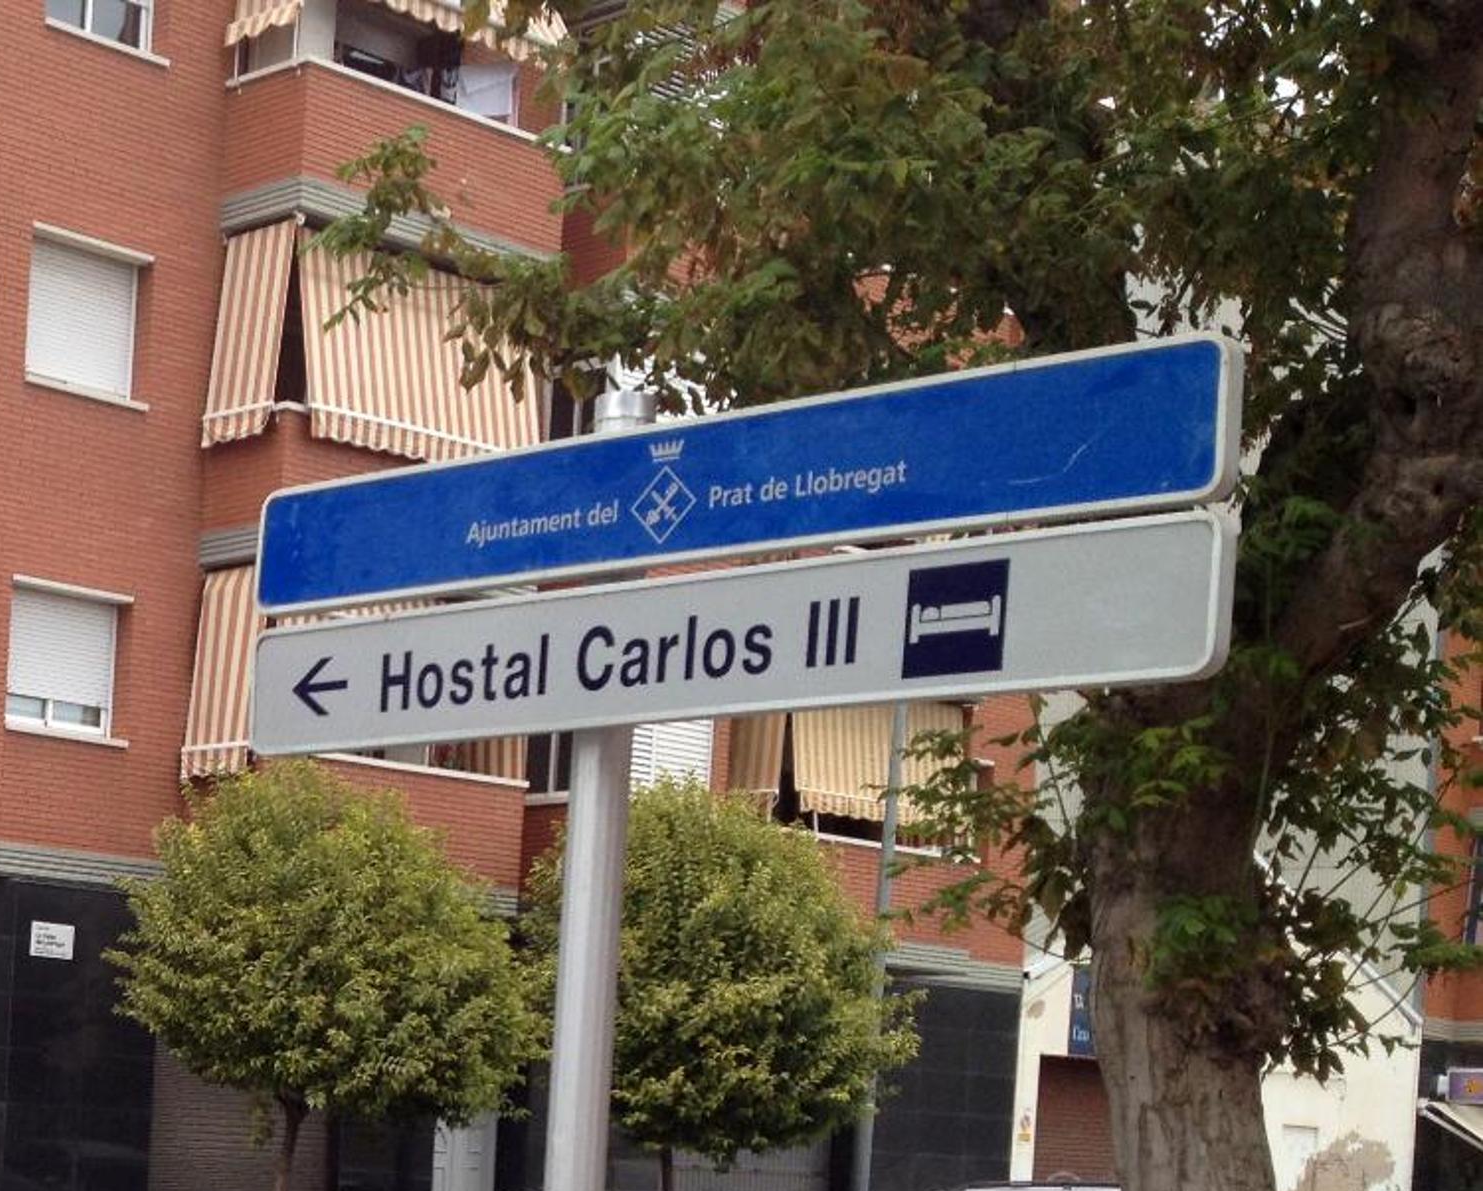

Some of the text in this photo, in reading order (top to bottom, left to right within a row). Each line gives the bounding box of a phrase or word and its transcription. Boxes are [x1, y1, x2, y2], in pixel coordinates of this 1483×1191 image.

[466, 460, 907, 548] Ajuntament del Prat de Llobregat
[380, 596, 860, 713] Hostal Carlos III
